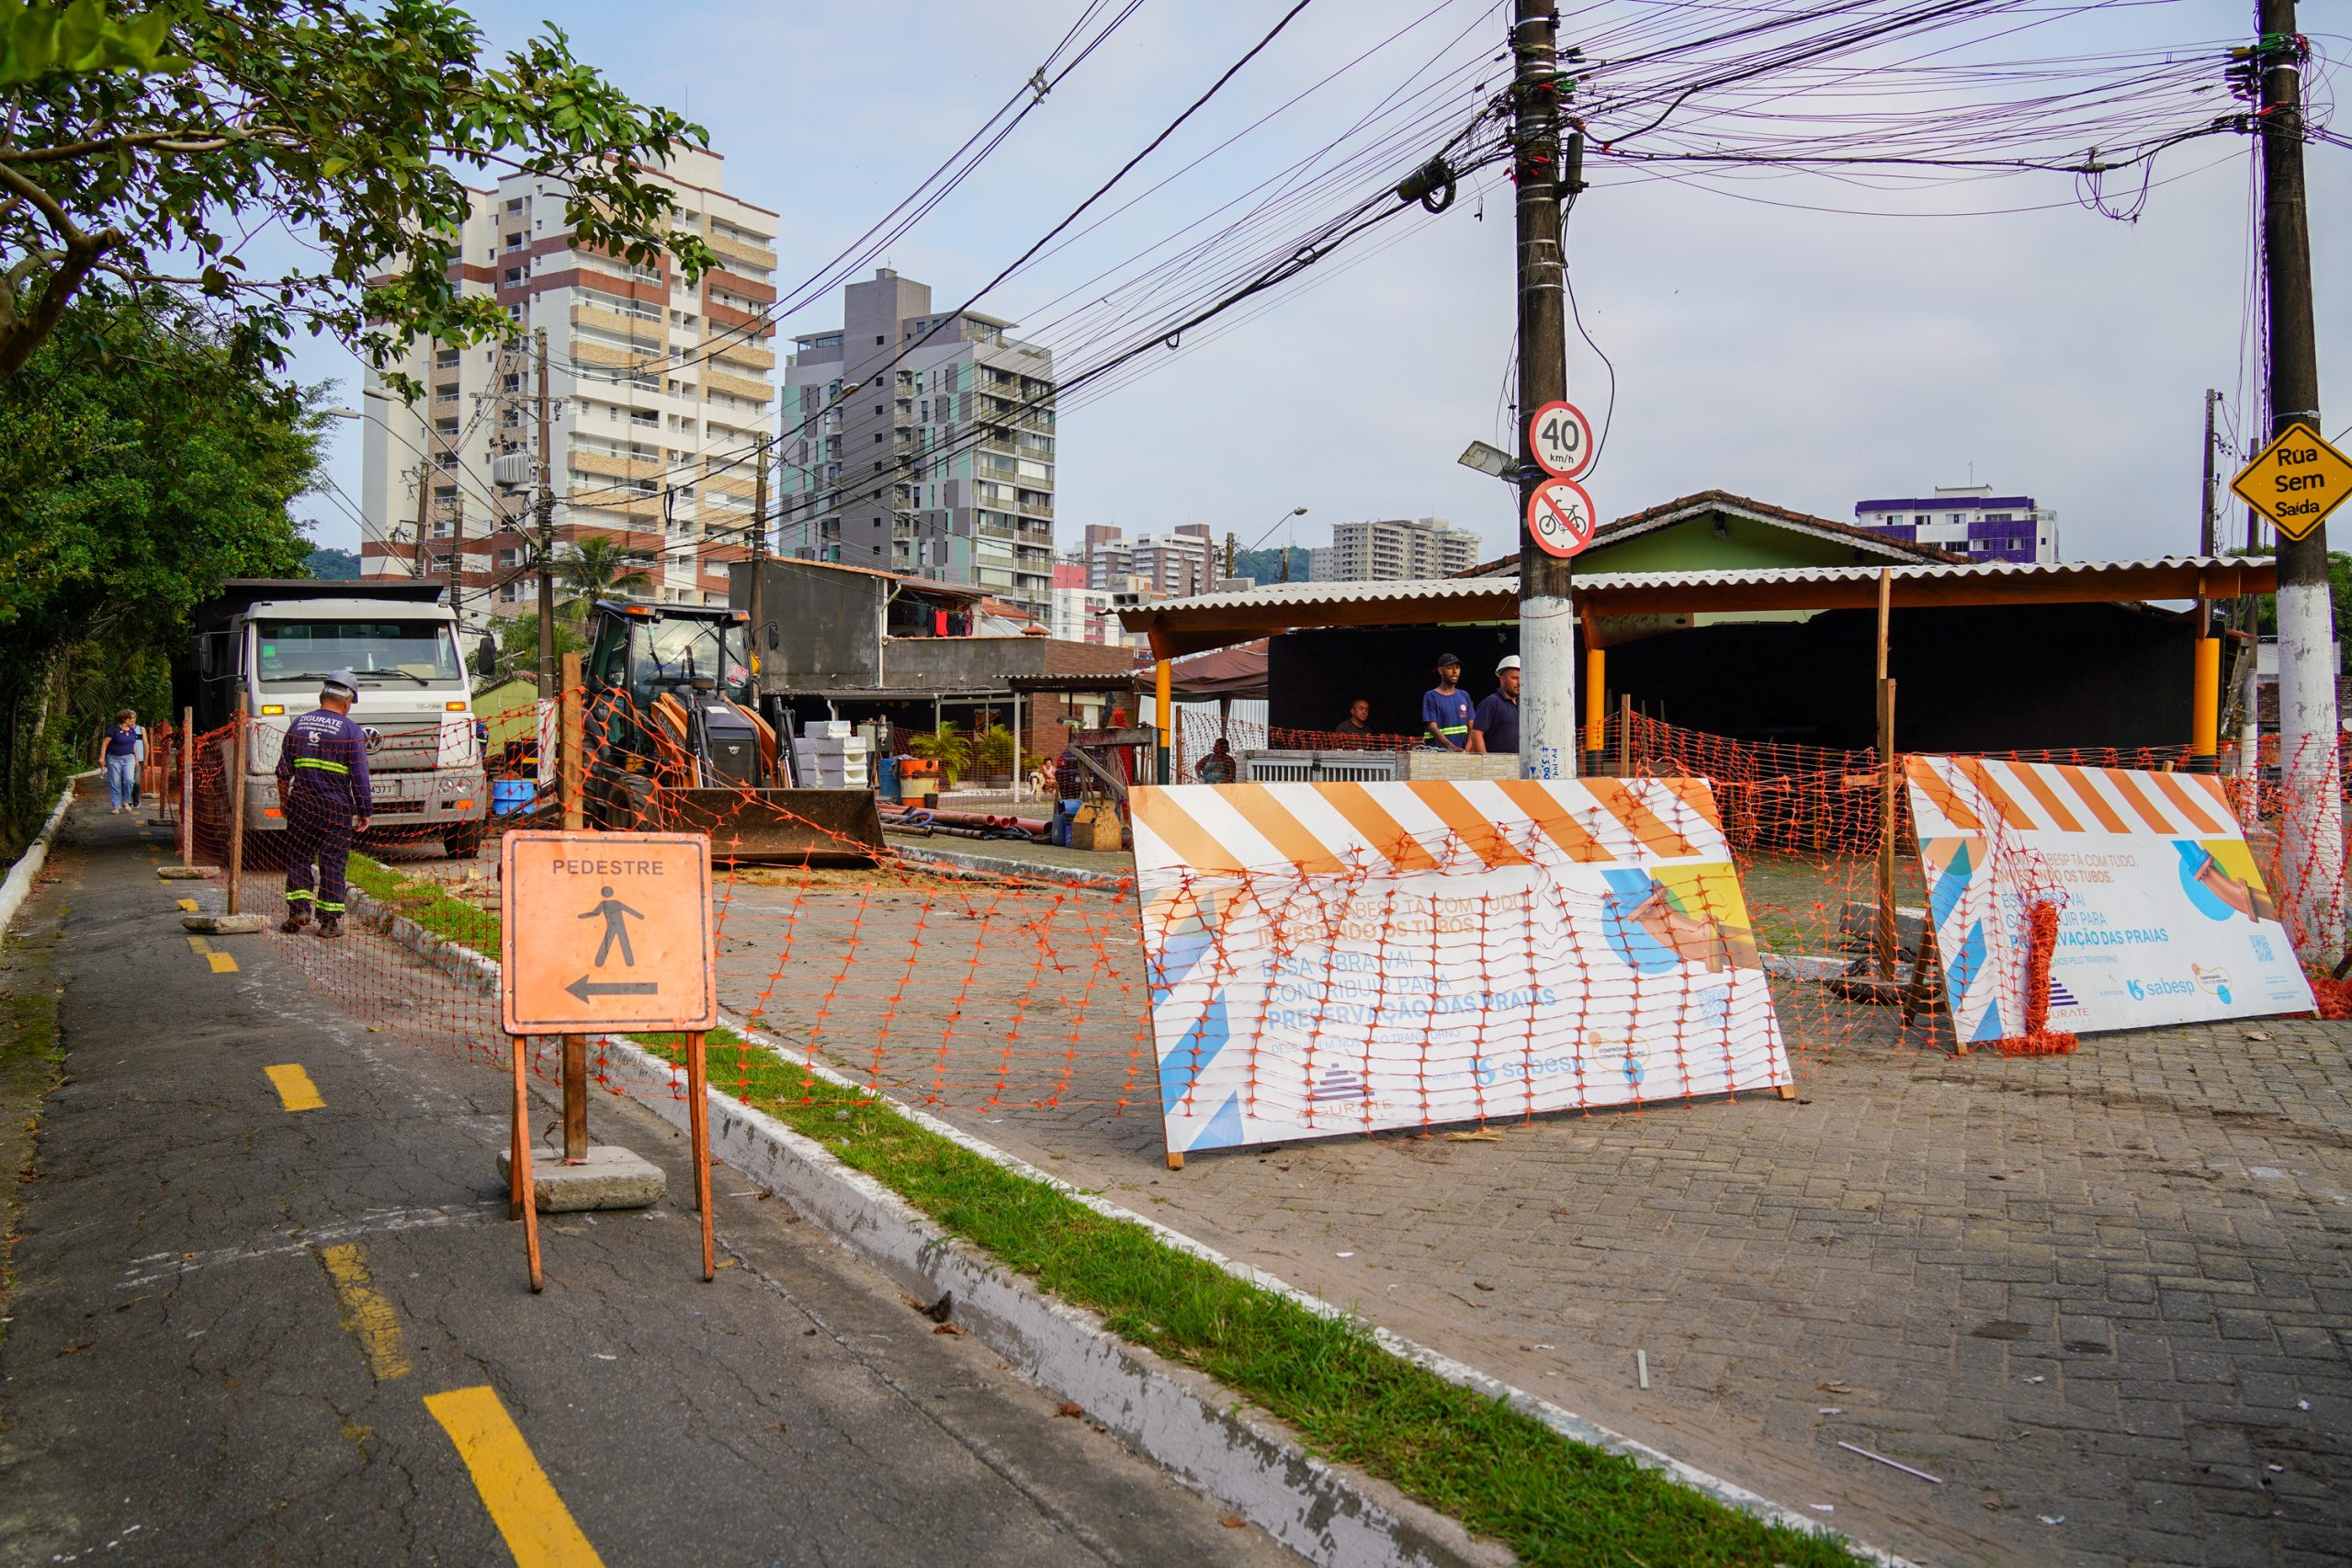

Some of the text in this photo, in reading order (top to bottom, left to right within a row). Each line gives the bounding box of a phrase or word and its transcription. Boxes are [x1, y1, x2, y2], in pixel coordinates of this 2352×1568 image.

[1542, 418, 1579, 452] 40
[1550, 454, 1574, 463] km/h
[2277, 448, 2318, 467] Rua
[2275, 474, 2324, 492] Sem
[2275, 499, 2320, 517] Saída
[300, 715, 344, 728] ZIGURATE
[552, 859, 664, 875] PEDESTRE
[2085, 853, 2108, 867] COM
[2109, 853, 2139, 868] TUDO,
[2064, 871, 2078, 883] OS
[2080, 871, 2114, 884] TUBOS.
[2069, 892, 2086, 907] VAI
[2080, 911, 2108, 927] PARA
[2101, 930, 2124, 945] DAS
[2125, 927, 2169, 944] PRAIAS
[1261, 956, 1313, 978] ESSA
[1318, 953, 1377, 974] OBRA
[1264, 973, 1452, 1003] CONTRIBUIR PARA
[2146, 977, 2195, 996] sabesp
[1268, 987, 1556, 1030] PRESERVAÇÃO DAS PRAIAS
[1392, 1029, 1461, 1043] TRANSORNO
